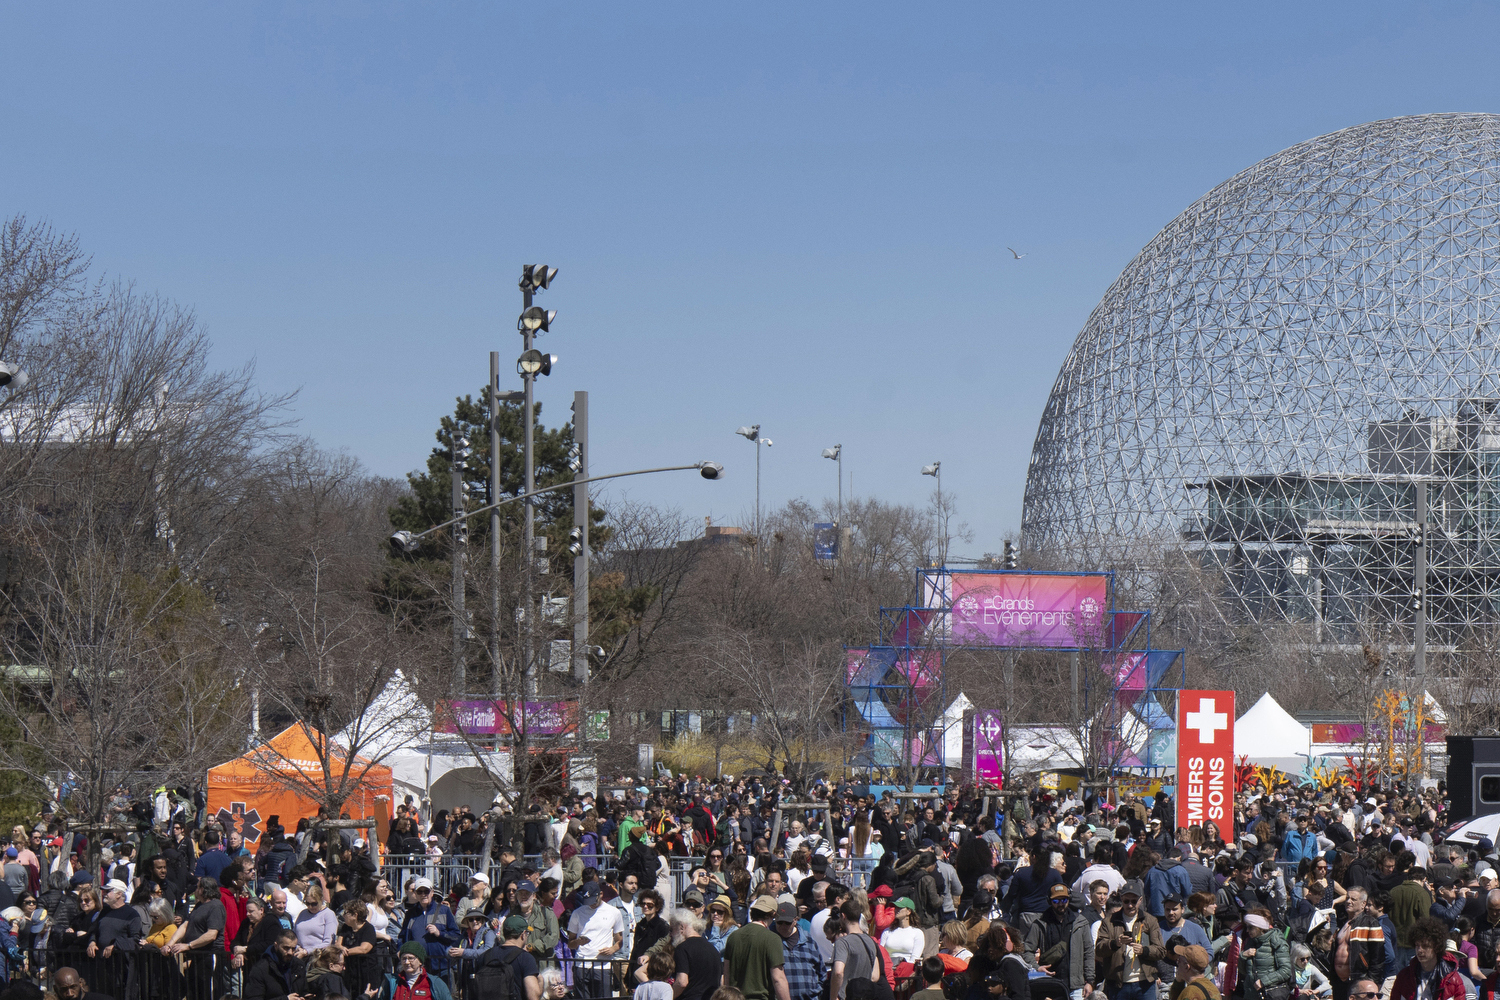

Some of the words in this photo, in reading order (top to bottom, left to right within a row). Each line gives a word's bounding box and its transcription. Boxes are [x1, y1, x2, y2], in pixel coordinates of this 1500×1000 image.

[992, 595, 1035, 611] Grands
[212, 775, 251, 783] SERVICES
[1187, 757, 1204, 829] EMIERS
[1208, 757, 1225, 820] SOINS
